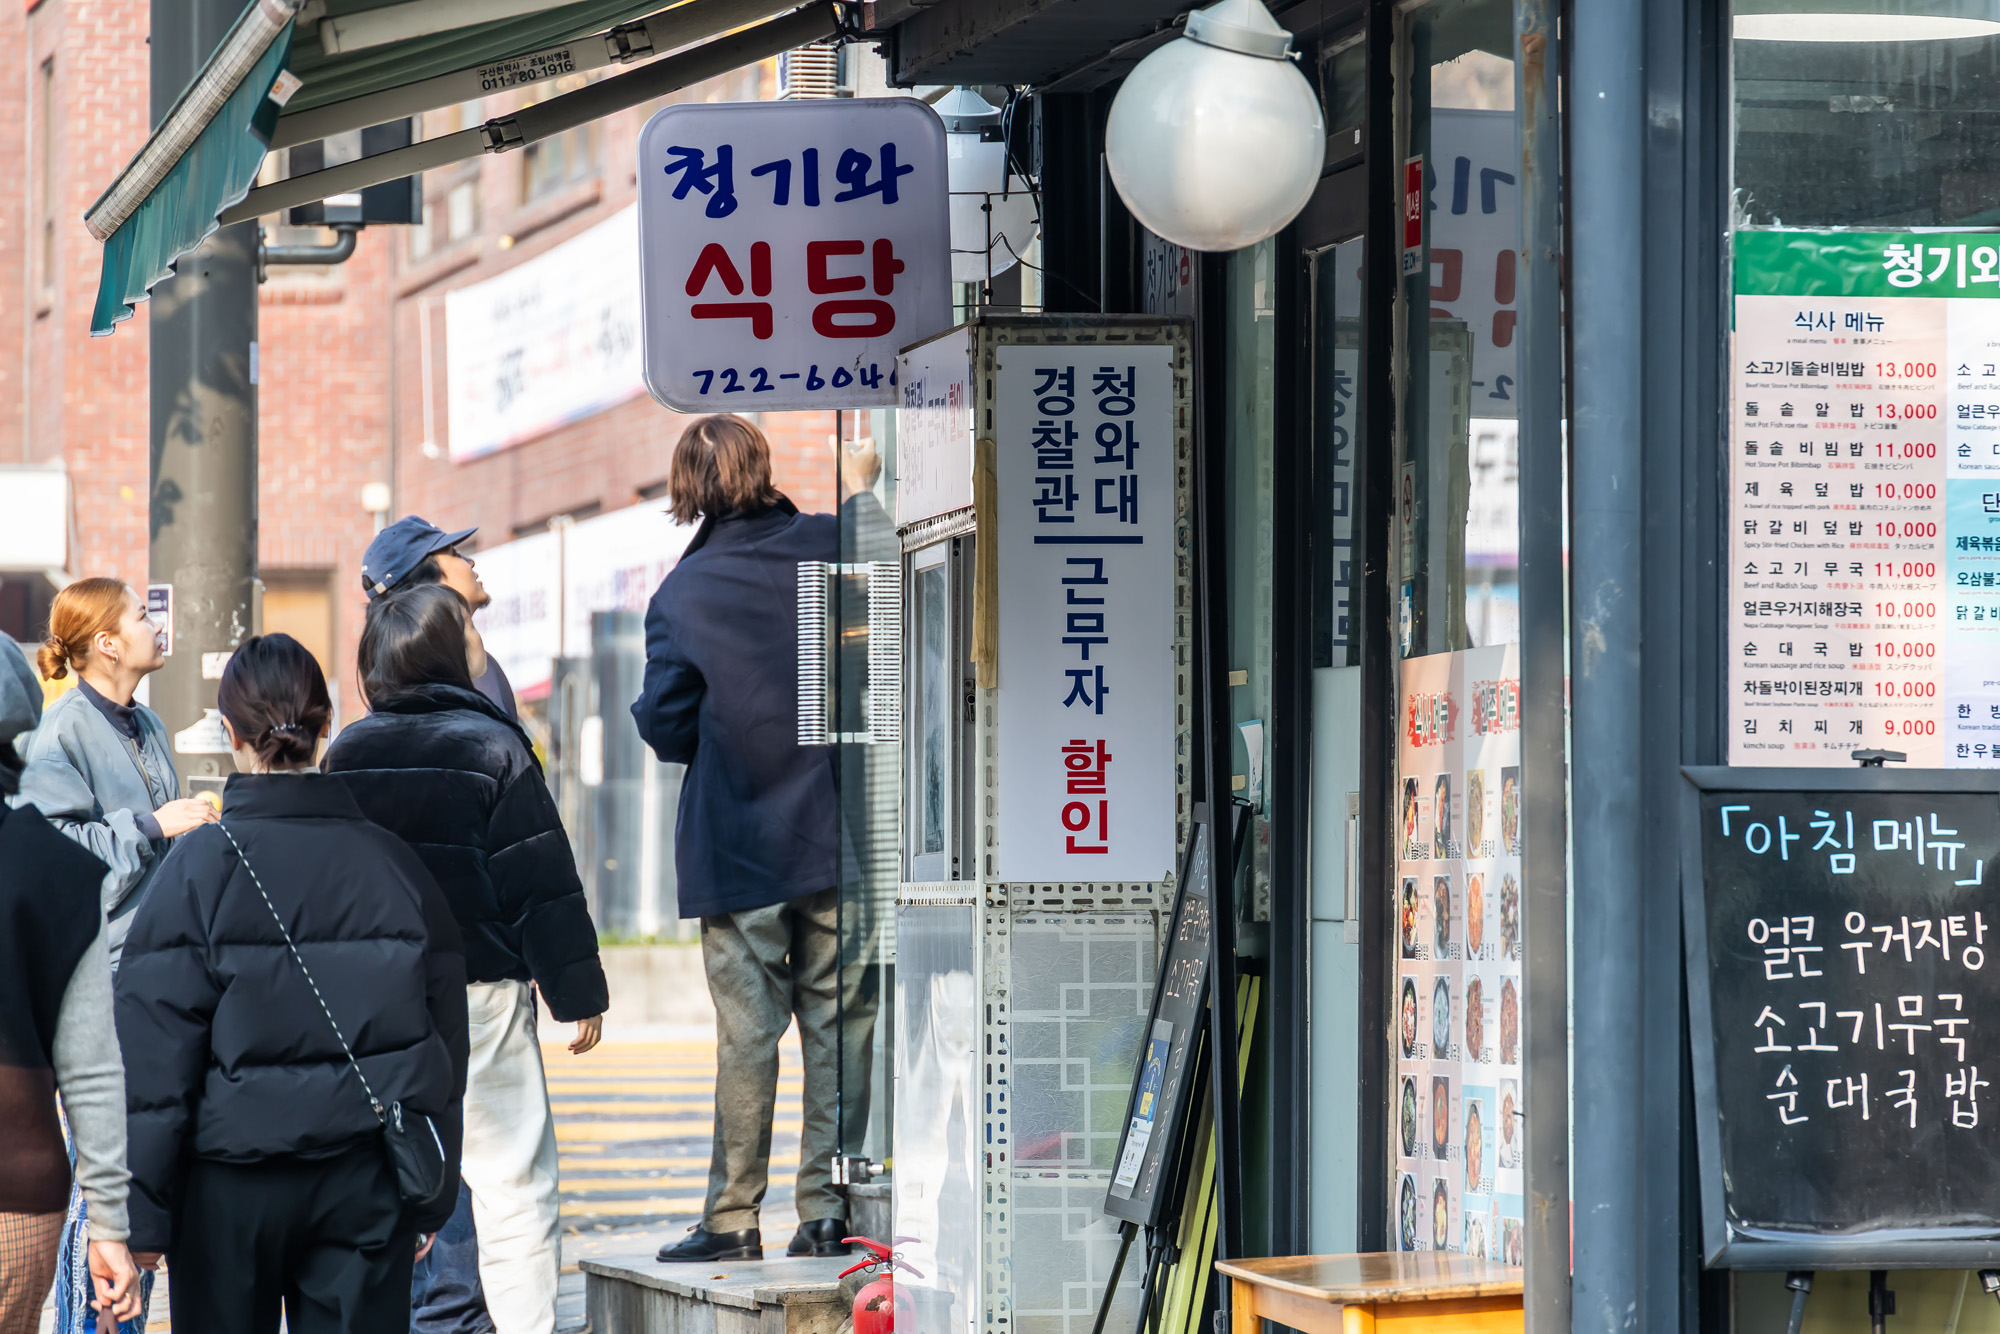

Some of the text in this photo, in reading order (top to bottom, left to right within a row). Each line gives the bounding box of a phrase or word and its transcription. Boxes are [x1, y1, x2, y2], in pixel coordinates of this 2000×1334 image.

[664, 142, 914, 218] 청기와
[685, 238, 905, 340] 식당
[1794, 311, 1885, 332] 식사 메뉴
[1745, 361, 1936, 379] 소고기돌솥비빔밥 13,000
[1876, 404, 1937, 420] 13,000
[1031, 366, 1079, 523] 경찰관
[1091, 366, 1140, 524] 청와대
[1875, 443, 1936, 460] 11,000
[1875, 483, 1936, 500] 10,000
[1876, 522, 1936, 538] 10,000
[1874, 562, 1936, 579] 11,000
[1744, 602, 1936, 618] 얼큰우거지해장국 10,000
[1874, 642, 1936, 659] 10,000
[1744, 680, 1936, 698] 차돌박이된장찌개 10,000
[1060, 558, 1112, 855] 근무자 할인
[1884, 720, 1936, 736] 9,000
[1748, 911, 1988, 980] 얼큰 우거지탕
[1754, 994, 1970, 1062] 소고기무국
[1766, 1064, 1990, 1128] 순대국밥
